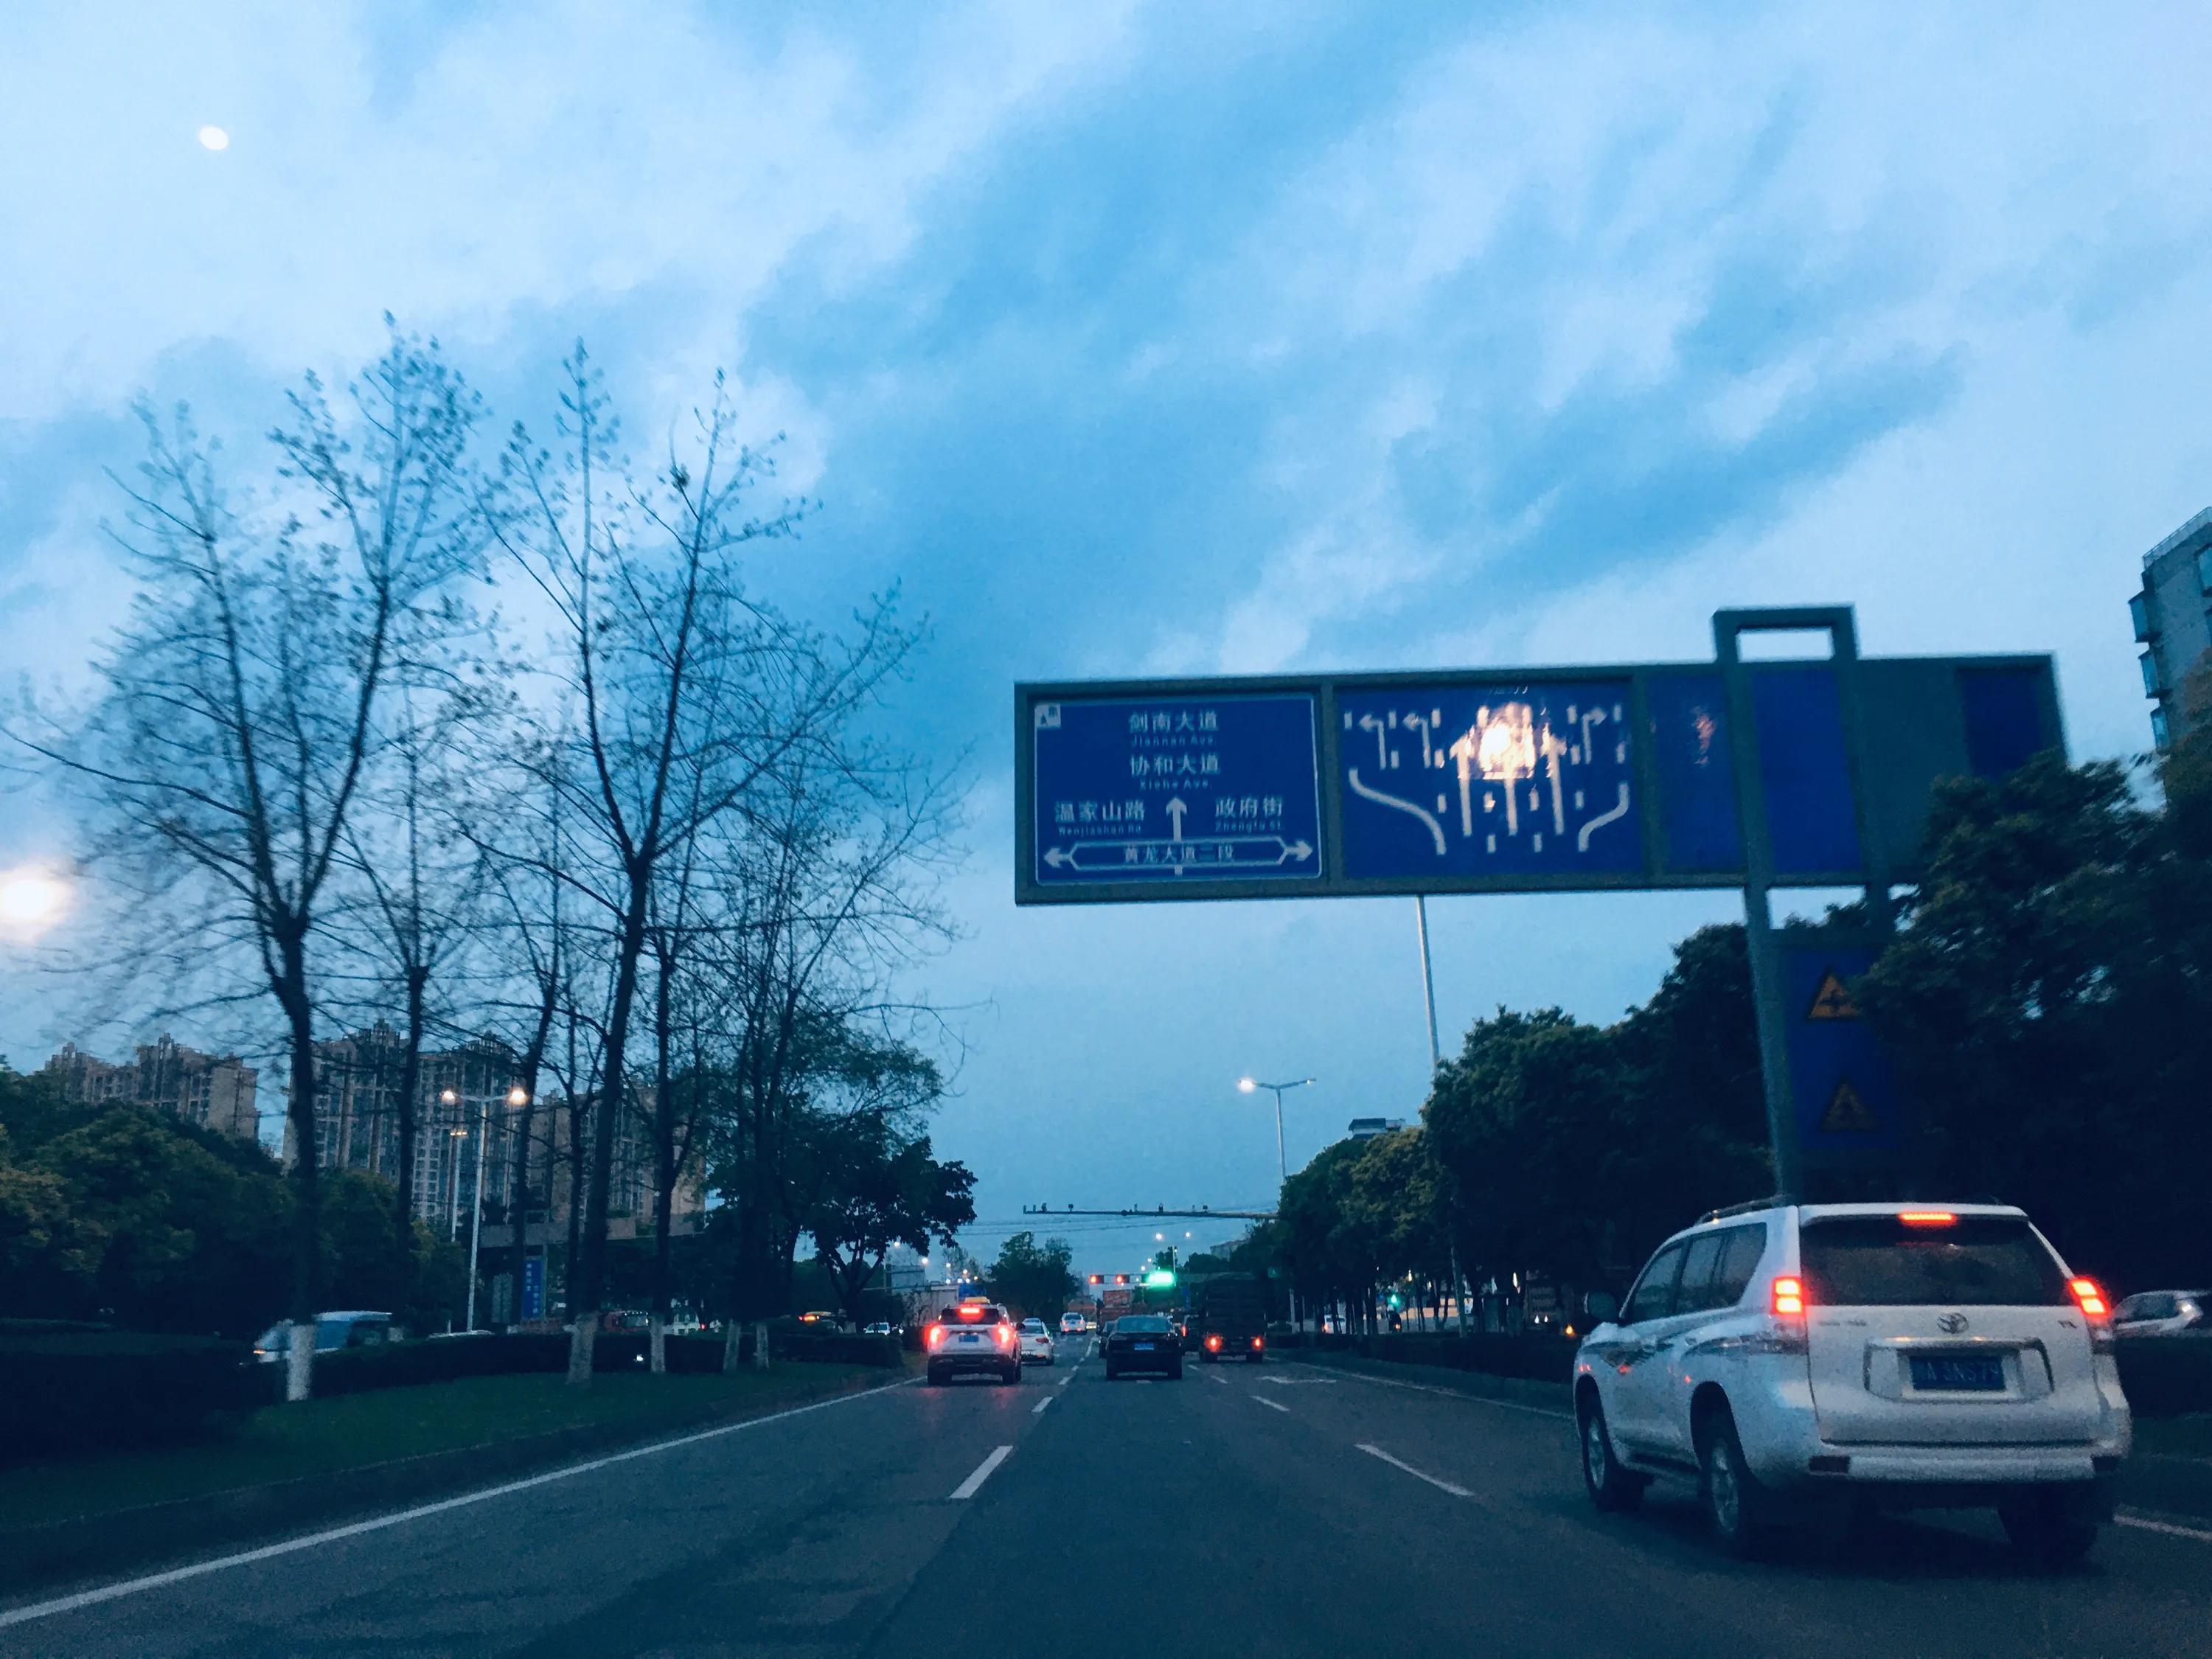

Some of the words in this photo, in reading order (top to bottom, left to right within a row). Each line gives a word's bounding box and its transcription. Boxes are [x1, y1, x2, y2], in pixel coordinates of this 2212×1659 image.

[1129, 710, 1219, 733] 剑南大道
[1132, 734, 1186, 748] Jiannan
[1130, 753, 1220, 776] 协和大道
[1139, 779, 1178, 791] Xiehe
[1054, 799, 1145, 823] 温家山路
[1215, 795, 1283, 818] 政府街
